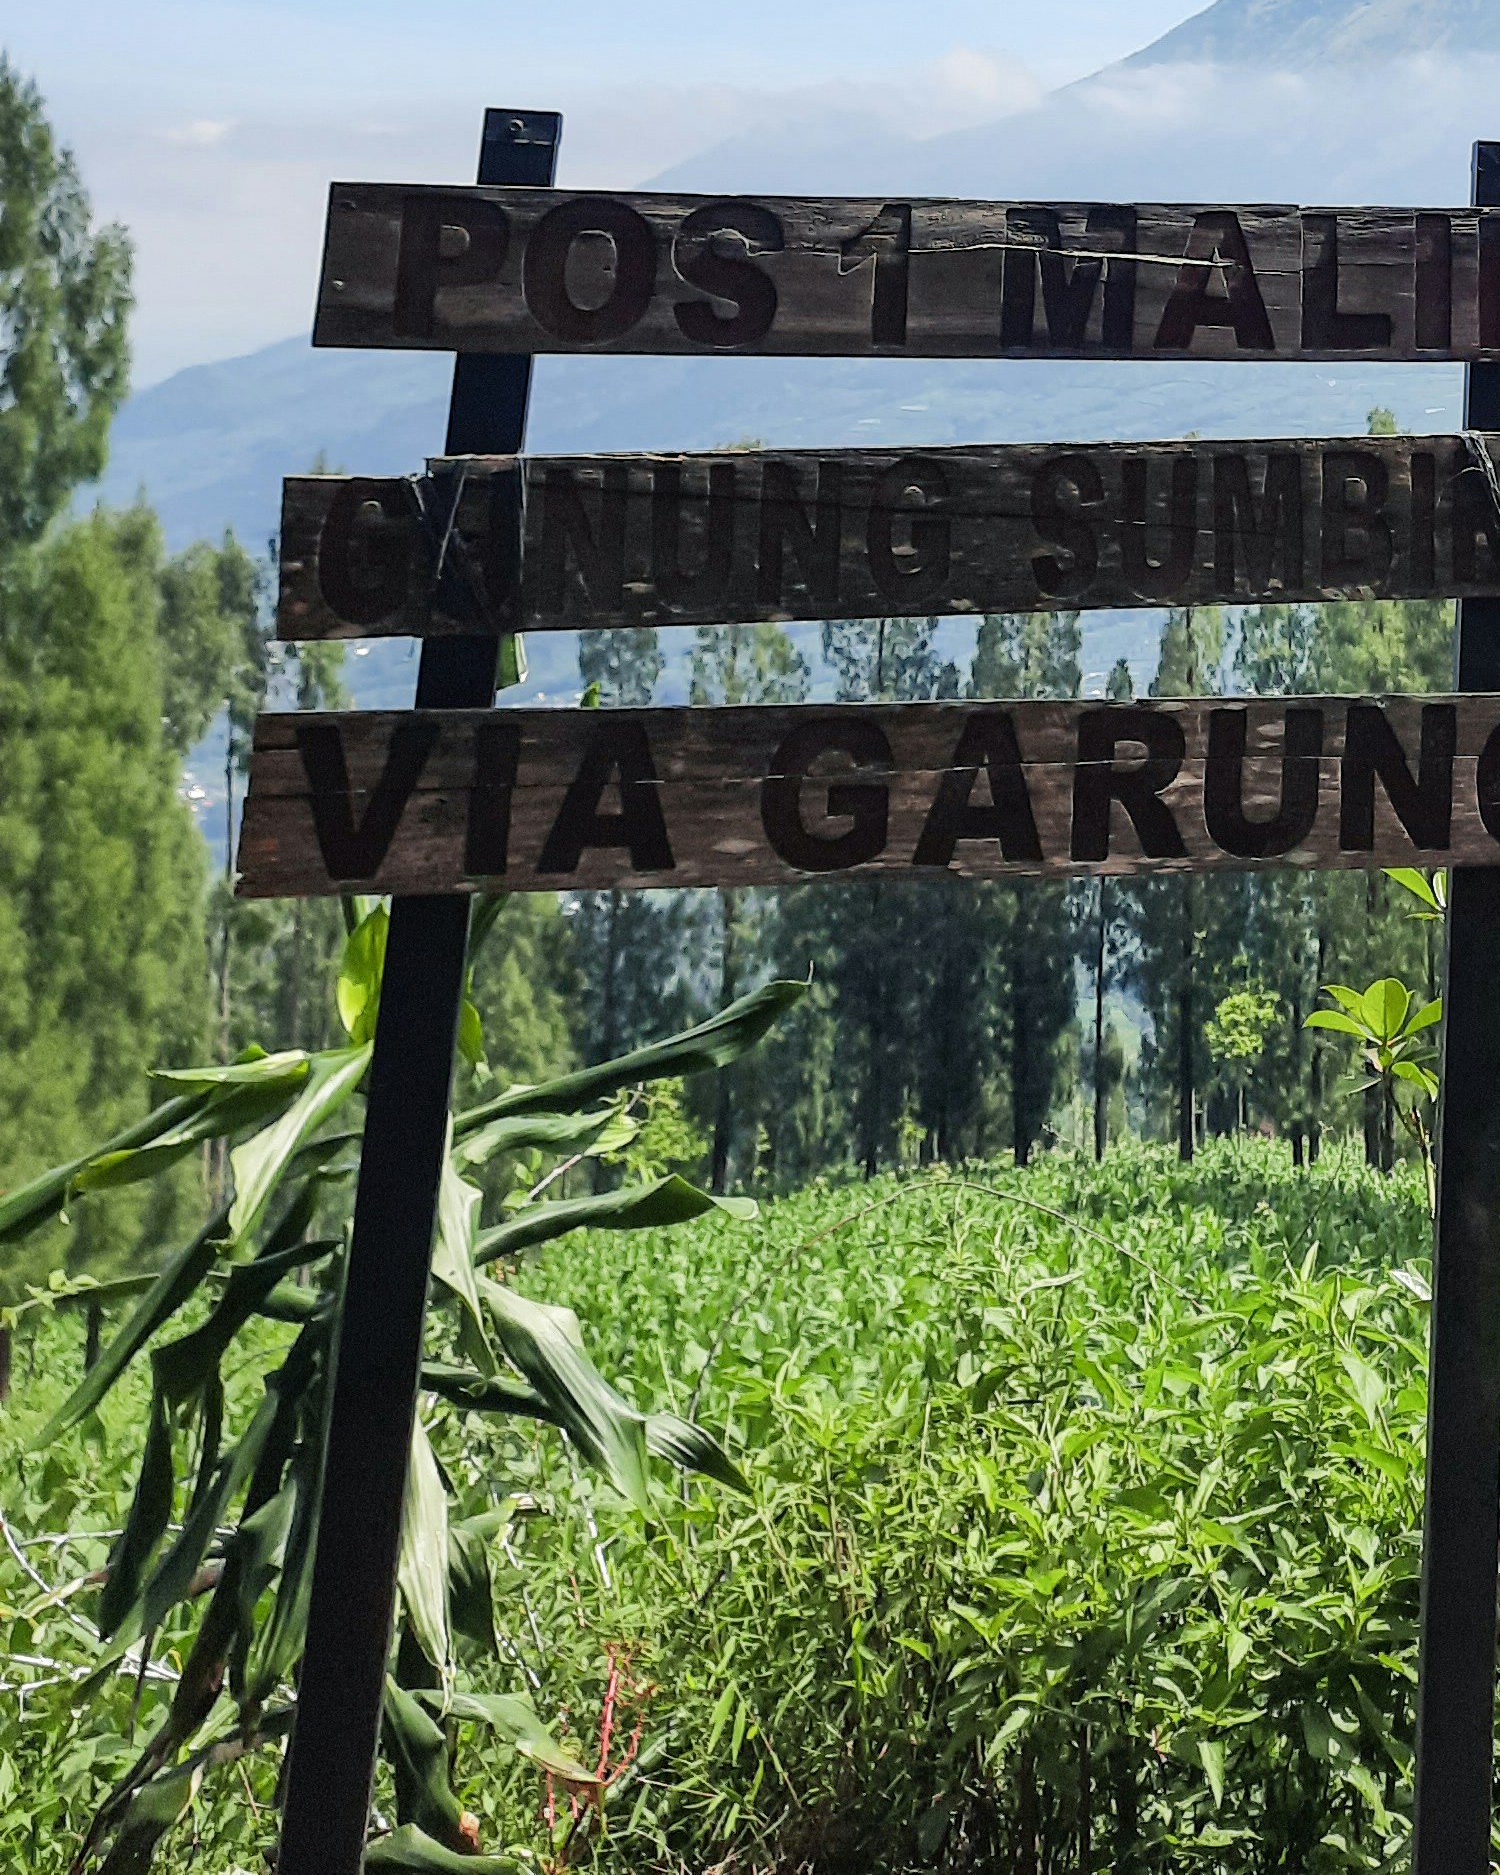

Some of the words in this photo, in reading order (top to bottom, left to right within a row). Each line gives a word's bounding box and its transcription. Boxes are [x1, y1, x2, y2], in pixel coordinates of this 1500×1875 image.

[394, 195, 784, 347] POS
[840, 203, 911, 348] 1
[297, 723, 677, 881] VIA
